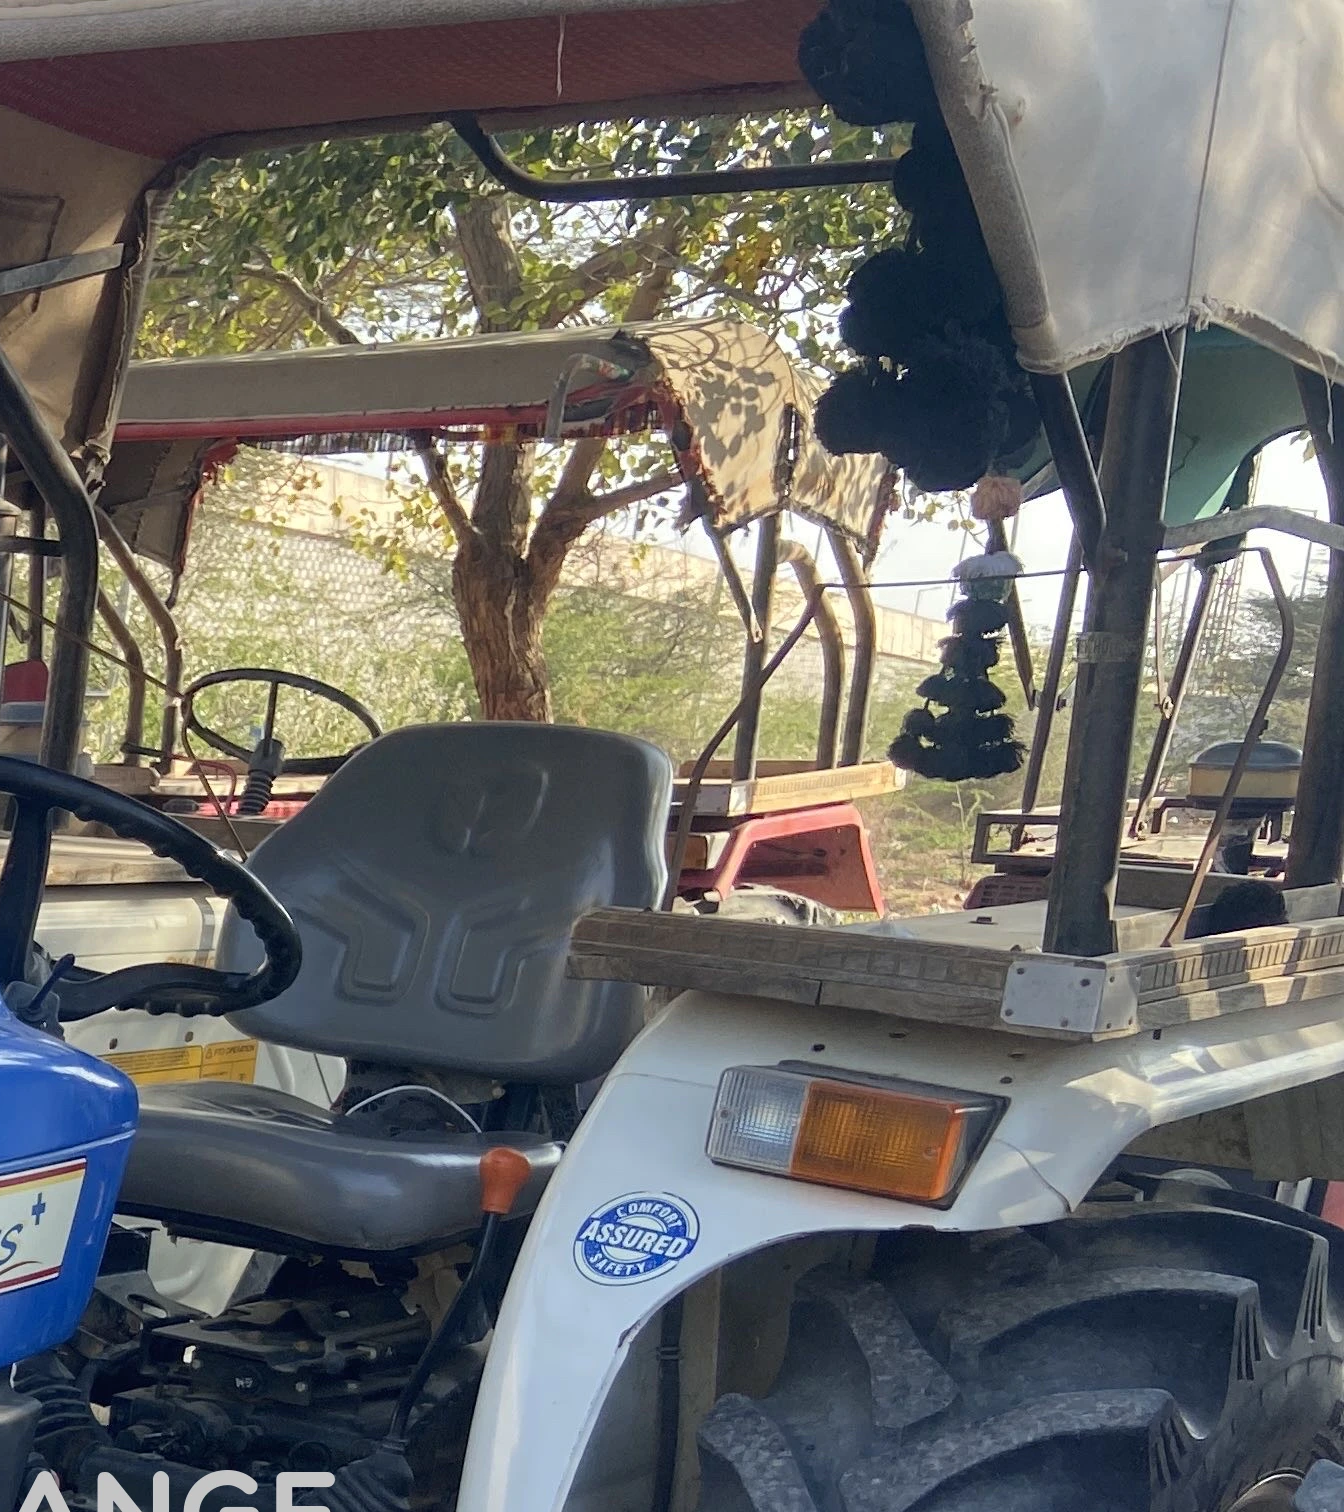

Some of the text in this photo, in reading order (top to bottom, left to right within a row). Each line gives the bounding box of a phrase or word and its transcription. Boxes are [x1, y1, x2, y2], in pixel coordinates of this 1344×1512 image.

[616, 1201, 683, 1229] COMFORT
[579, 1219, 689, 1259] ASSURED
[589, 1252, 647, 1276] SAFETY
